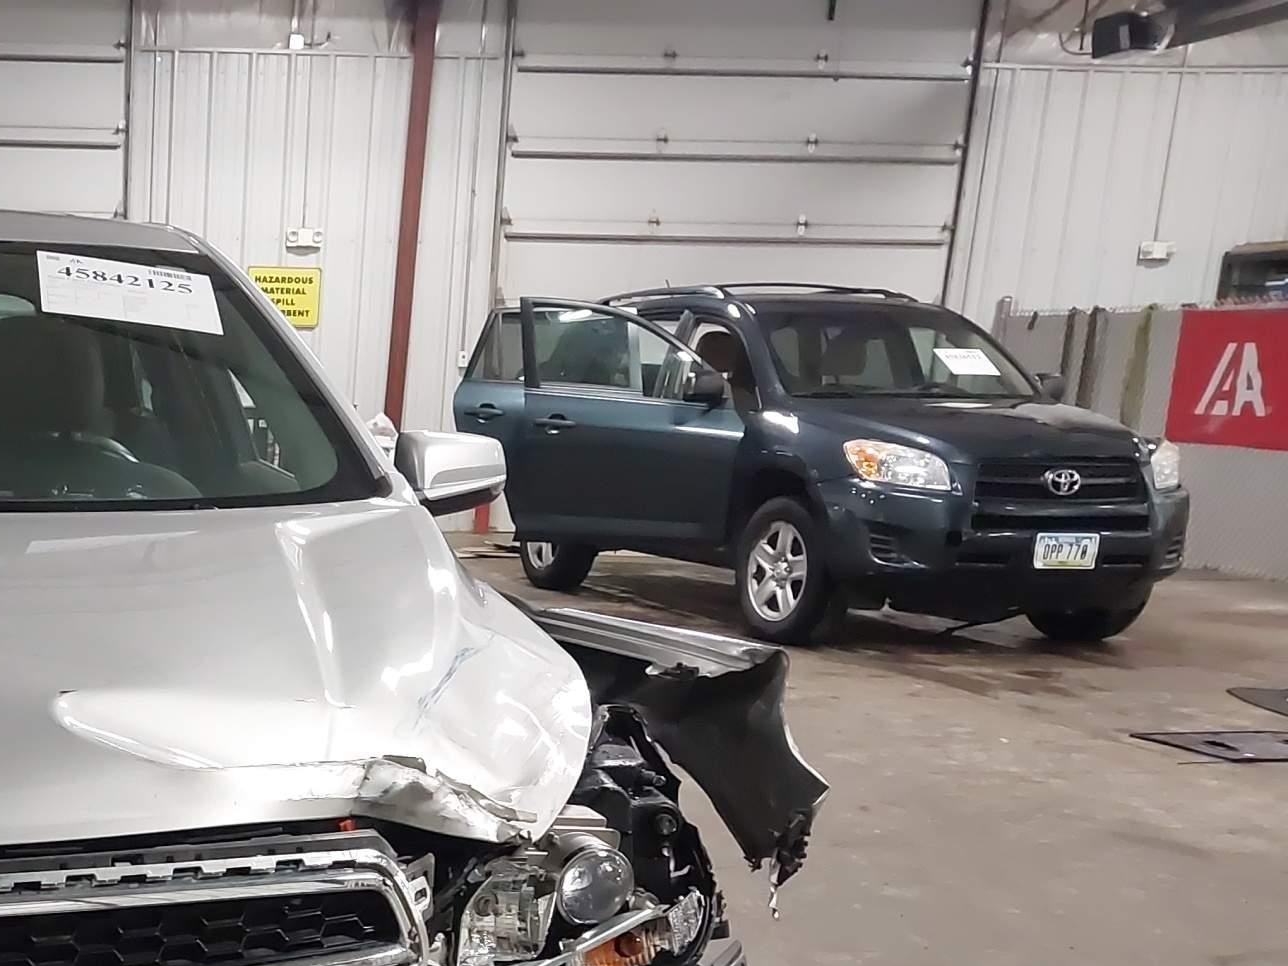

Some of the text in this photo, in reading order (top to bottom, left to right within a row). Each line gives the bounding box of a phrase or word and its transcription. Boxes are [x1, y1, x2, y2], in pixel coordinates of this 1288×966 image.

[57, 266, 193, 294] 45842125
[255, 276, 314, 285] HAZARDOUS
[261, 287, 307, 295] MATERIAL
